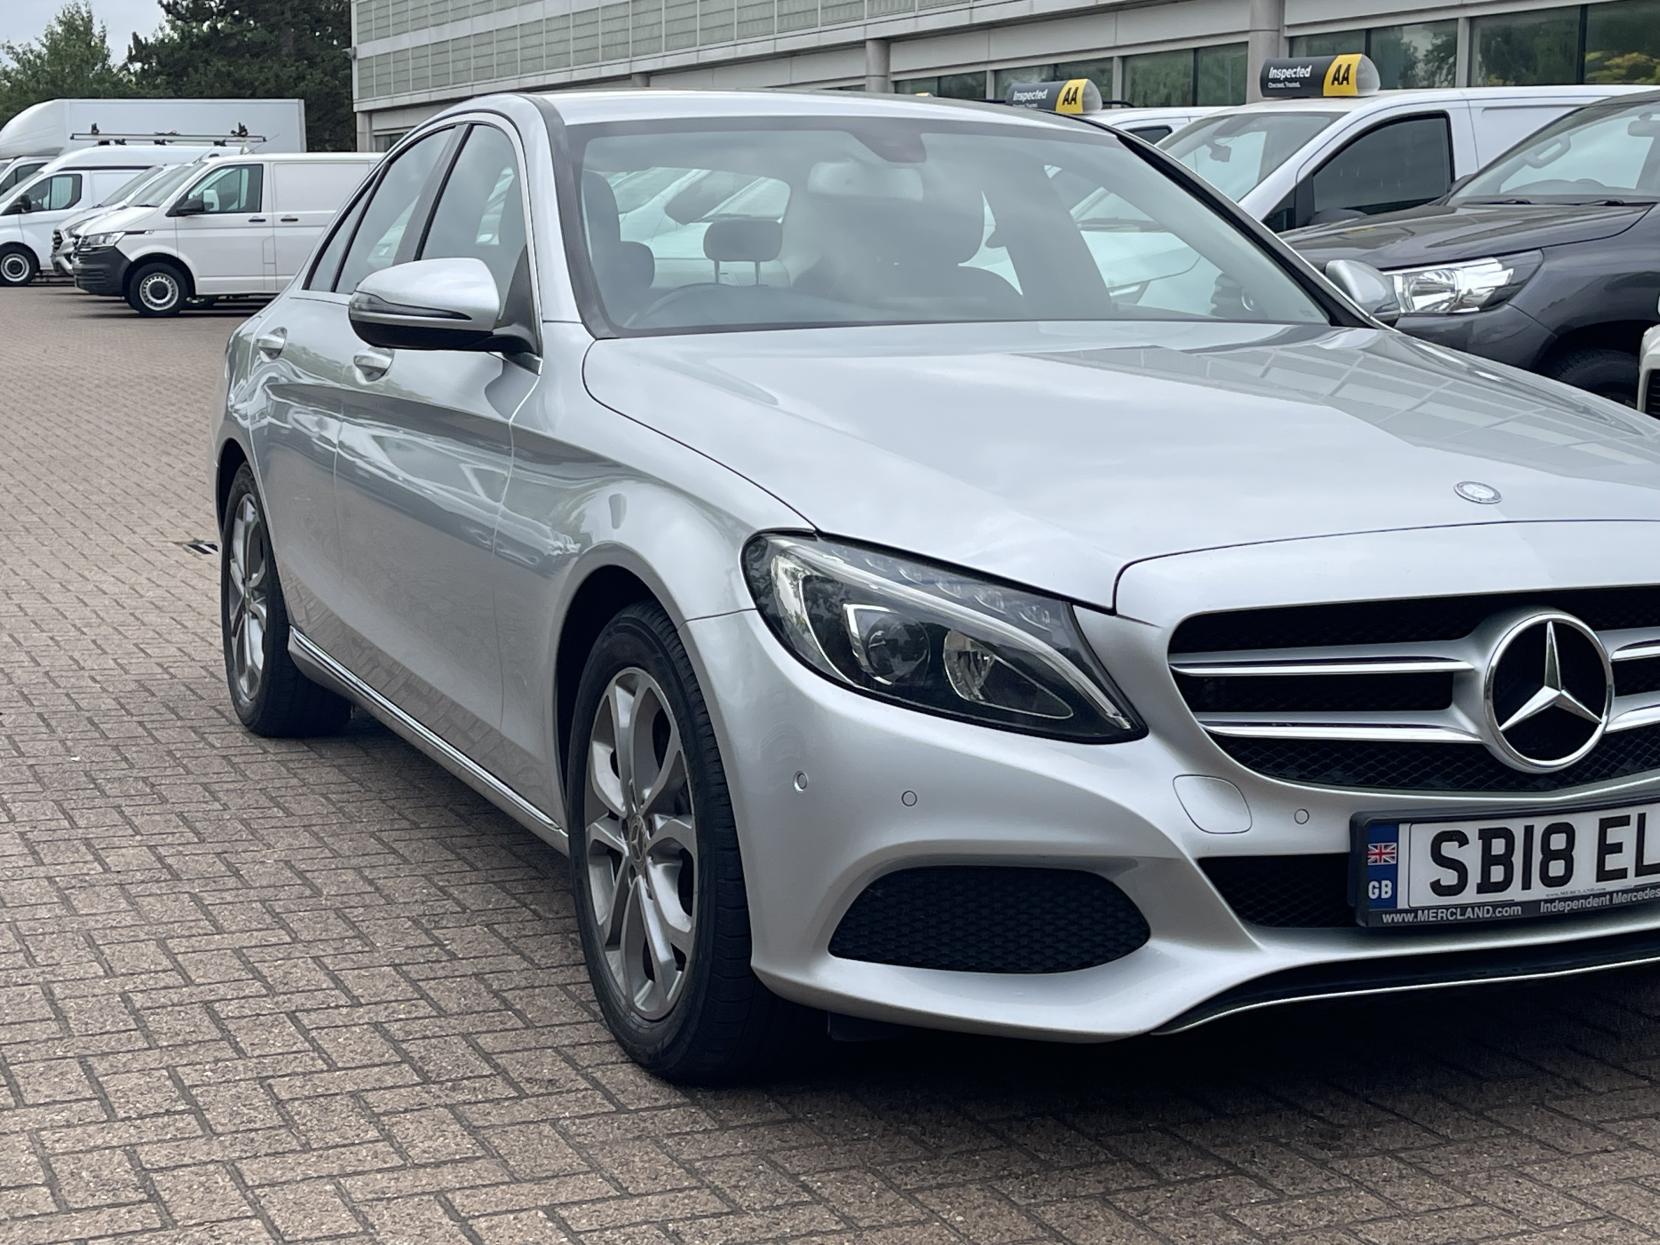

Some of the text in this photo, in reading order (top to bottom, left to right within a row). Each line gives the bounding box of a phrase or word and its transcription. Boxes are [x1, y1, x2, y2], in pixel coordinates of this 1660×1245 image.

[1268, 65, 1312, 80] Inspected
[1331, 64, 1351, 86] AA
[1013, 89, 1048, 102] Inspected
[1062, 87, 1079, 106] AA
[1429, 821, 1576, 897] SB18
[1368, 880, 1393, 899] GB
[1540, 894, 1610, 913] Independent
[1382, 905, 1522, 923] www.MERCLAND.com
